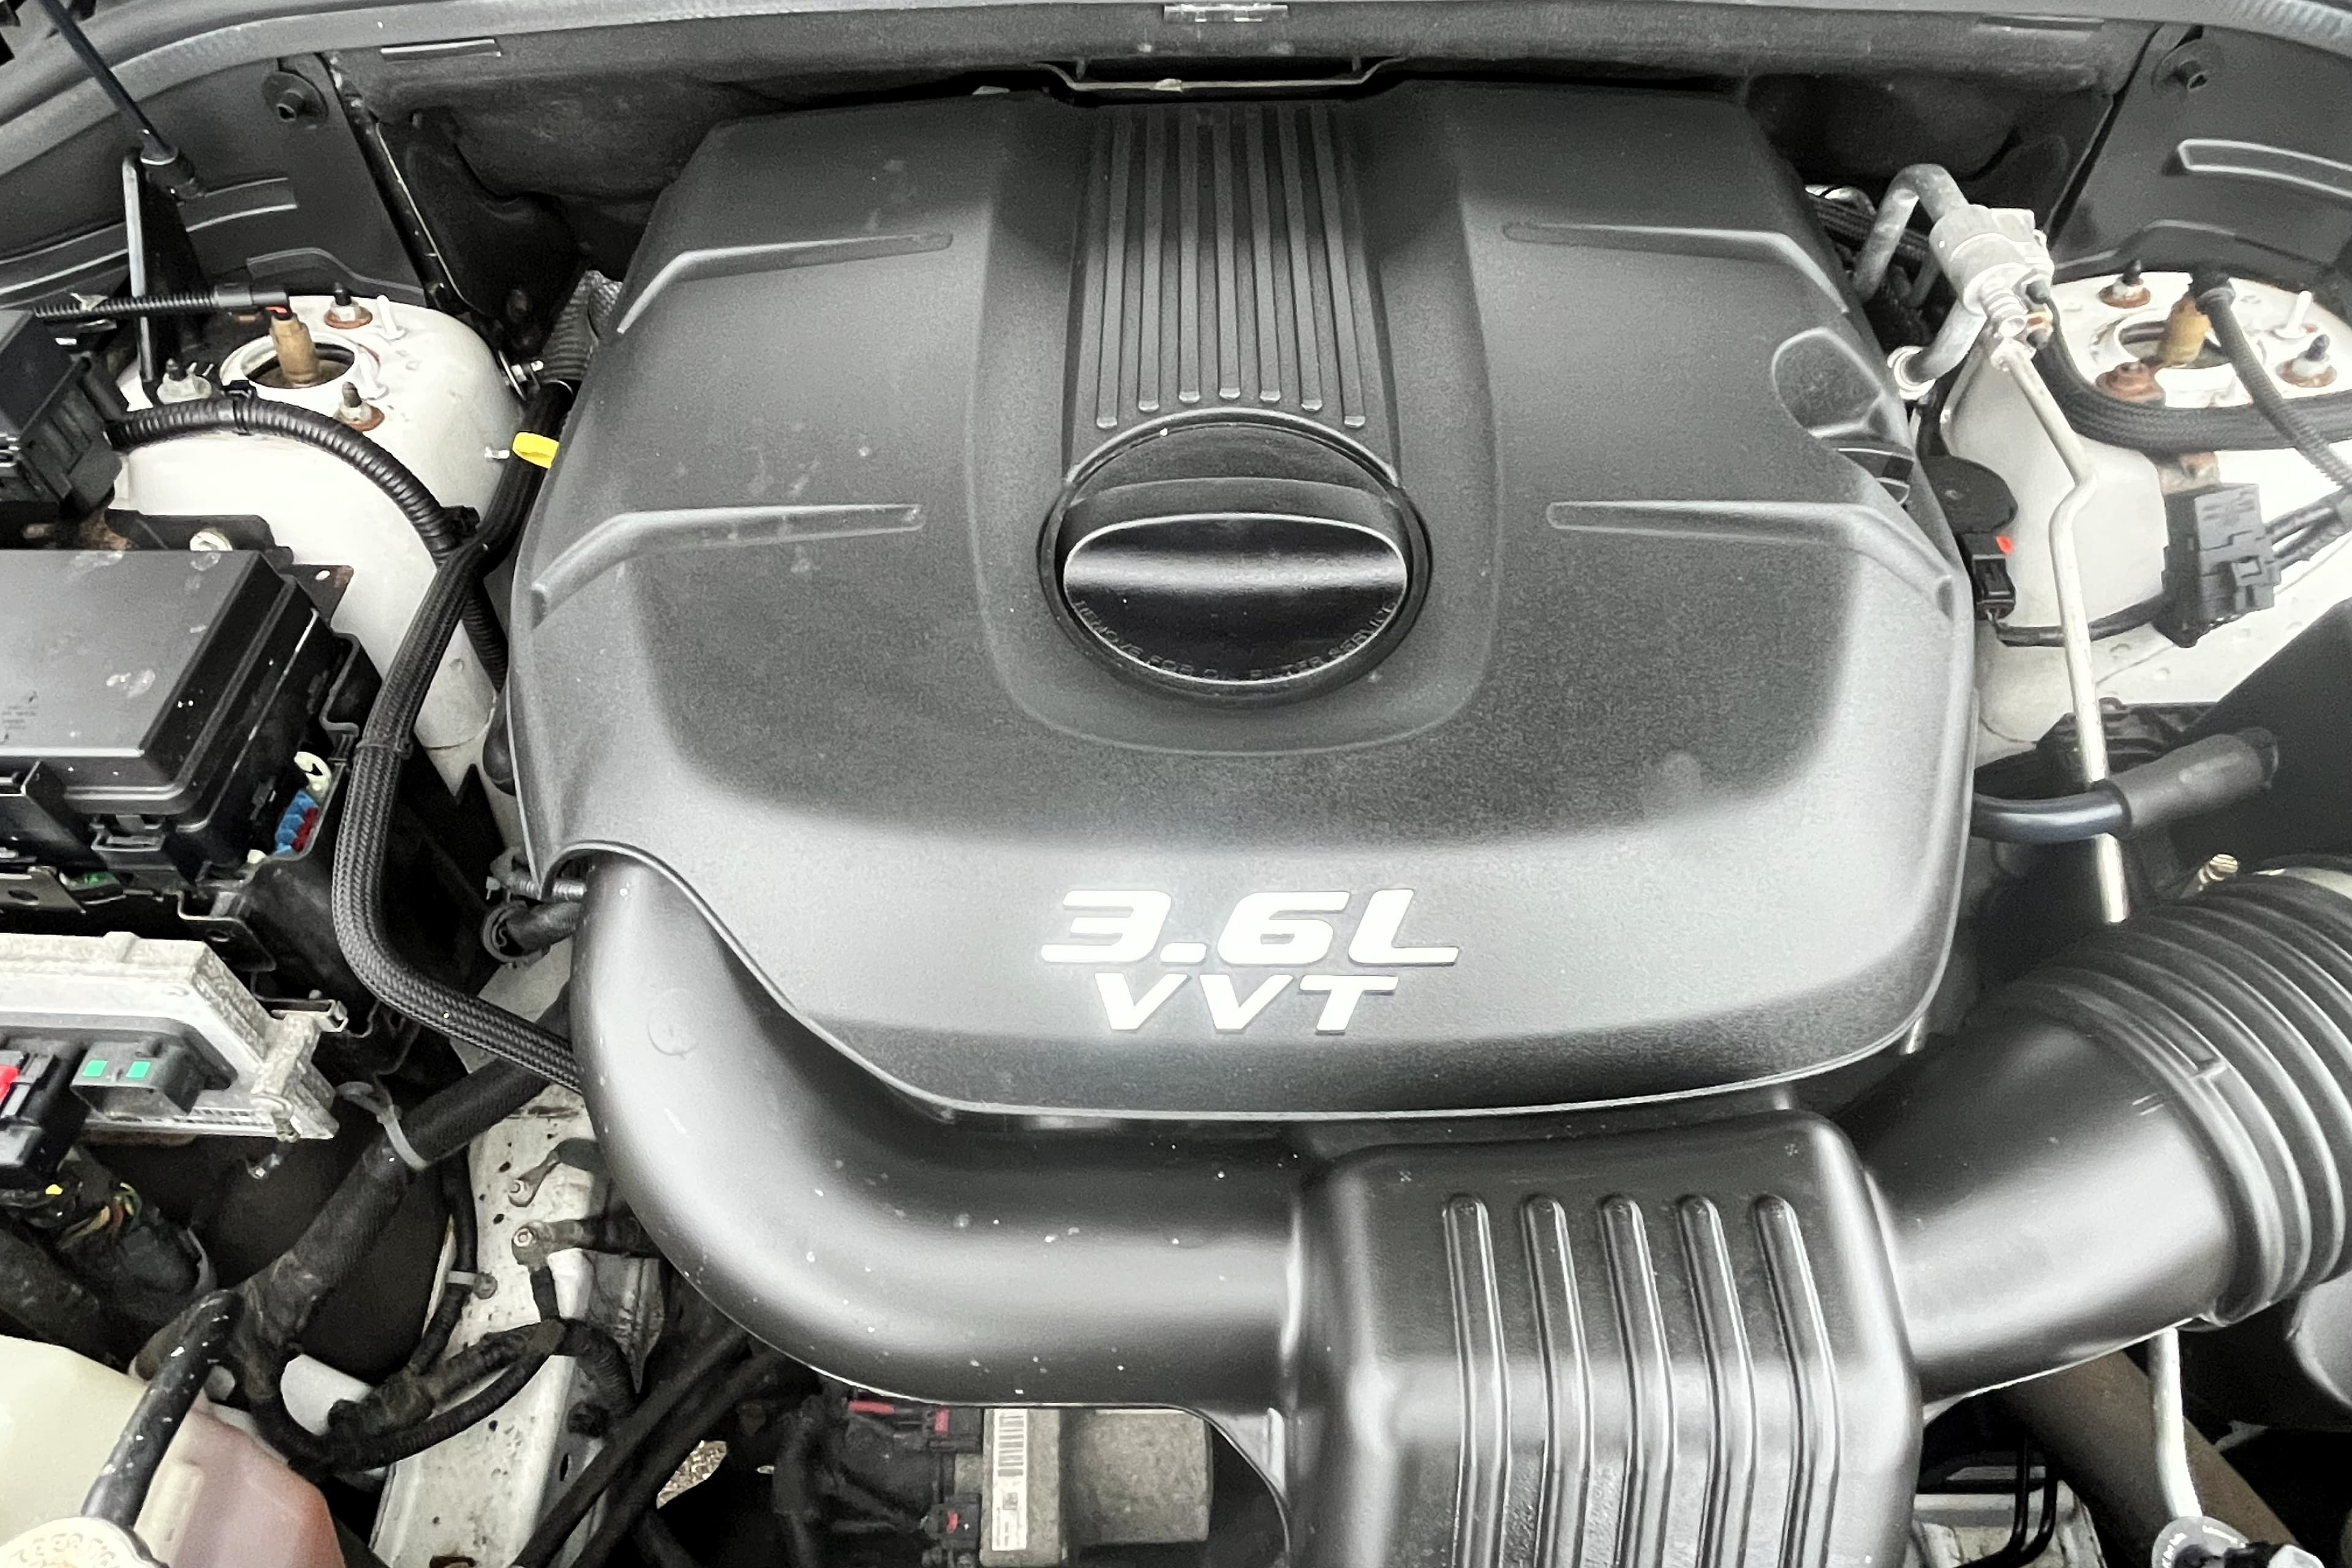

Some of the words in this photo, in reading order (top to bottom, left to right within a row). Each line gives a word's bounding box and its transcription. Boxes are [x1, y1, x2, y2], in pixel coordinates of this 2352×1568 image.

[1148, 654, 1194, 677] FOR
[1041, 888, 1459, 967] 3.6L
[1095, 971, 1399, 1035] VVT
